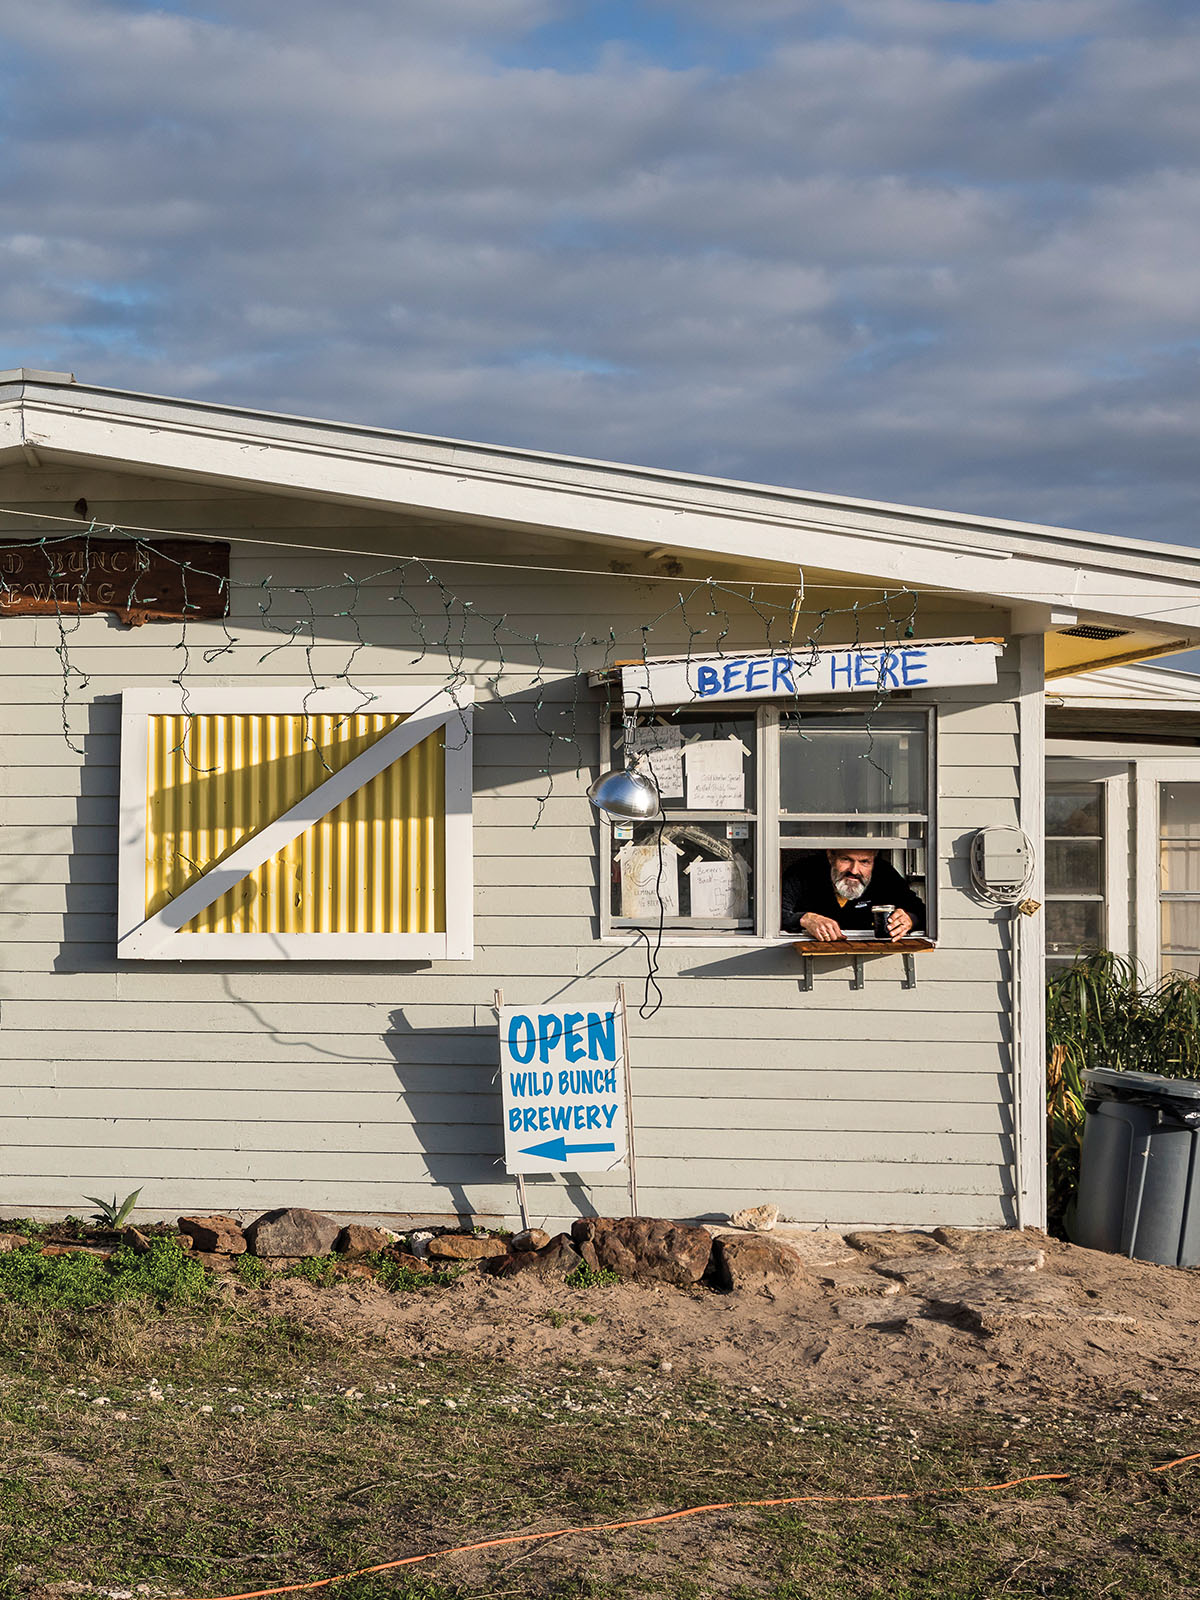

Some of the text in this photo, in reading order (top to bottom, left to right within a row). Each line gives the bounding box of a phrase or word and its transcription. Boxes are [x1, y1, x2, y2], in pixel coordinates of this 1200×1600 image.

[47, 551, 152, 573] BUNCH
[697, 651, 928, 697] BEER HERE
[507, 1011, 617, 1064] OPEN
[509, 1069, 617, 1097] WILD BUNCH
[508, 1103, 618, 1132] BREWERY
